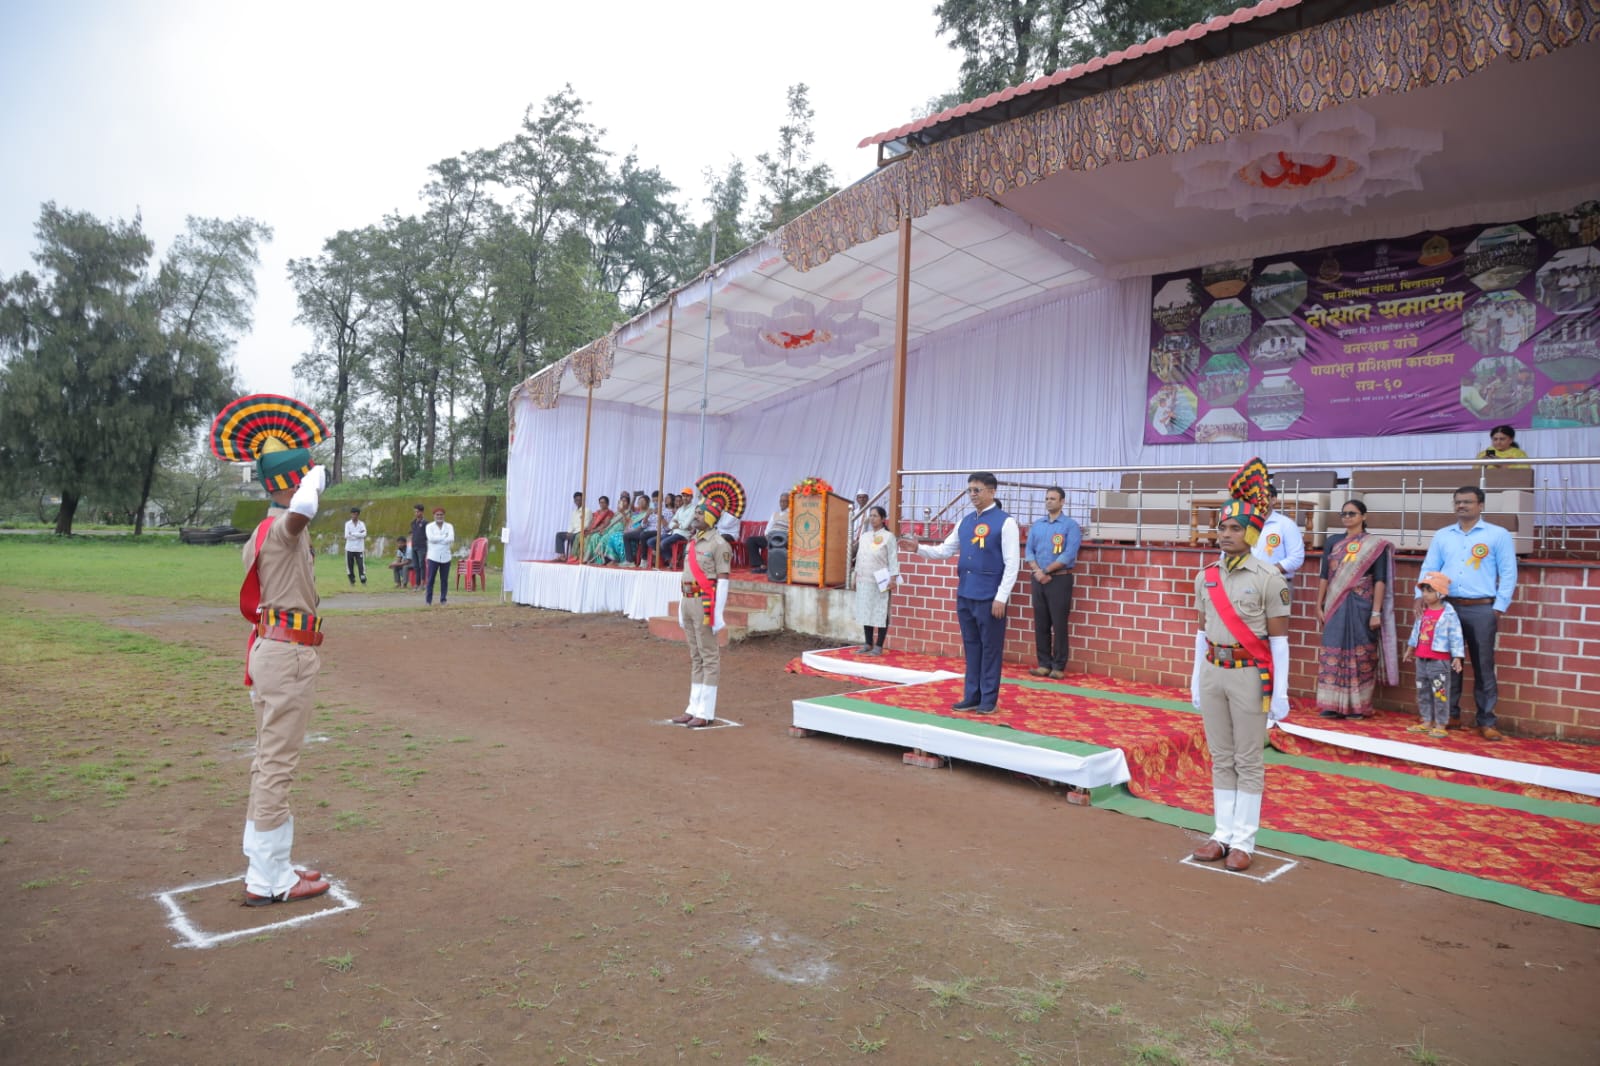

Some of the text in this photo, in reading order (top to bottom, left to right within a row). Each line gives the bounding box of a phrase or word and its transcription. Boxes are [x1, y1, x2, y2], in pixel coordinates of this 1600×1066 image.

[1304, 287, 1466, 328] दीक्षांत समारंभ
[1343, 334, 1419, 355] वनरक्षक यांचे
[1310, 351, 1455, 379] पायाभूत प्रशिक्षण कार्यक्रम
[1355, 378, 1403, 392] सत्र-६०
